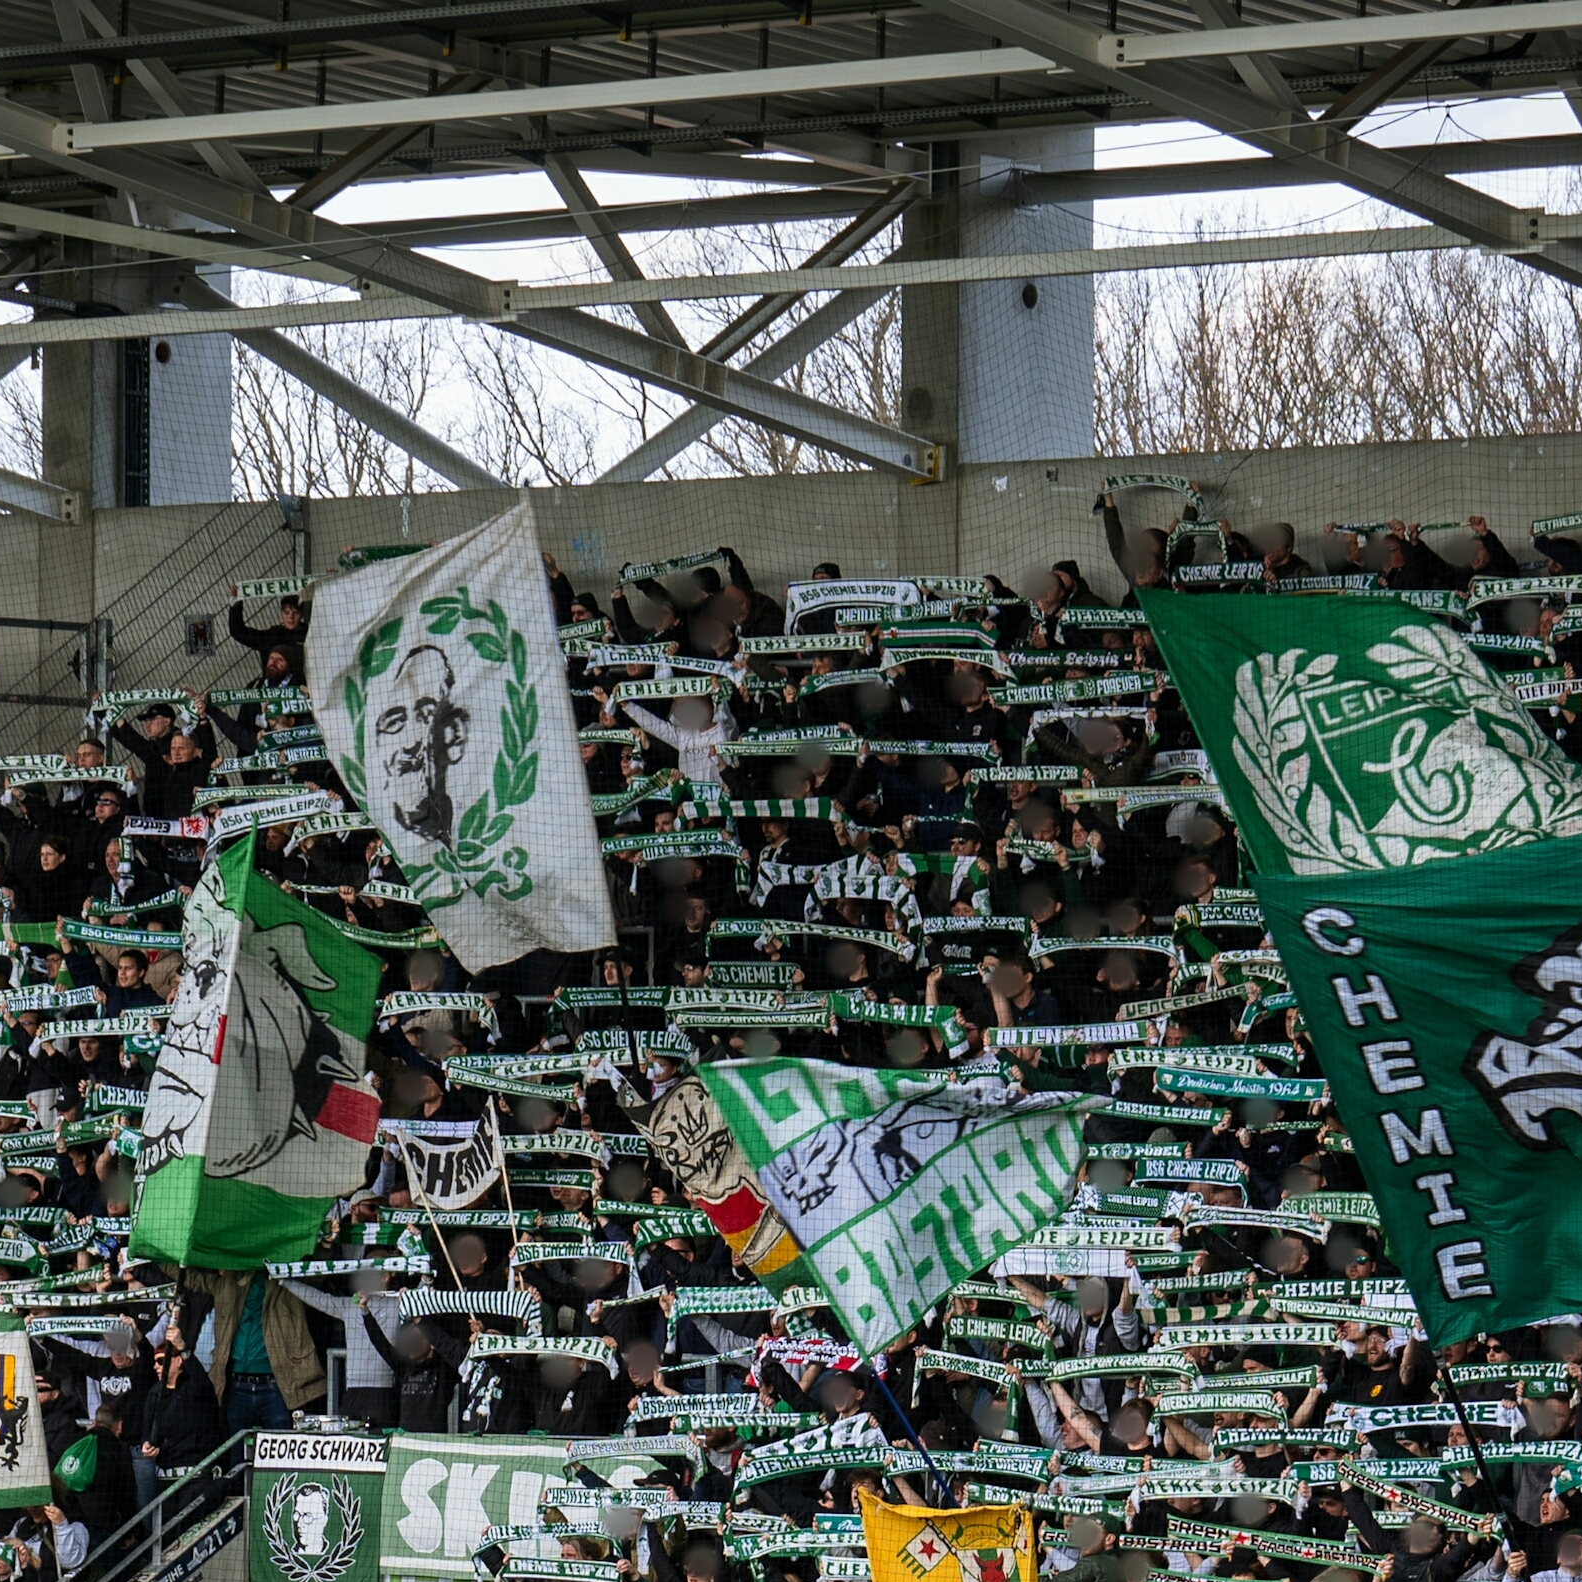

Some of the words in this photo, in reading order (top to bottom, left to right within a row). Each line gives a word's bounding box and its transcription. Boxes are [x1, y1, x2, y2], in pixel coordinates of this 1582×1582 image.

[1302, 906, 1493, 1301] CHEMIE
[258, 1438, 308, 1461] GEORG
[313, 1438, 387, 1463] SCHWARZ
